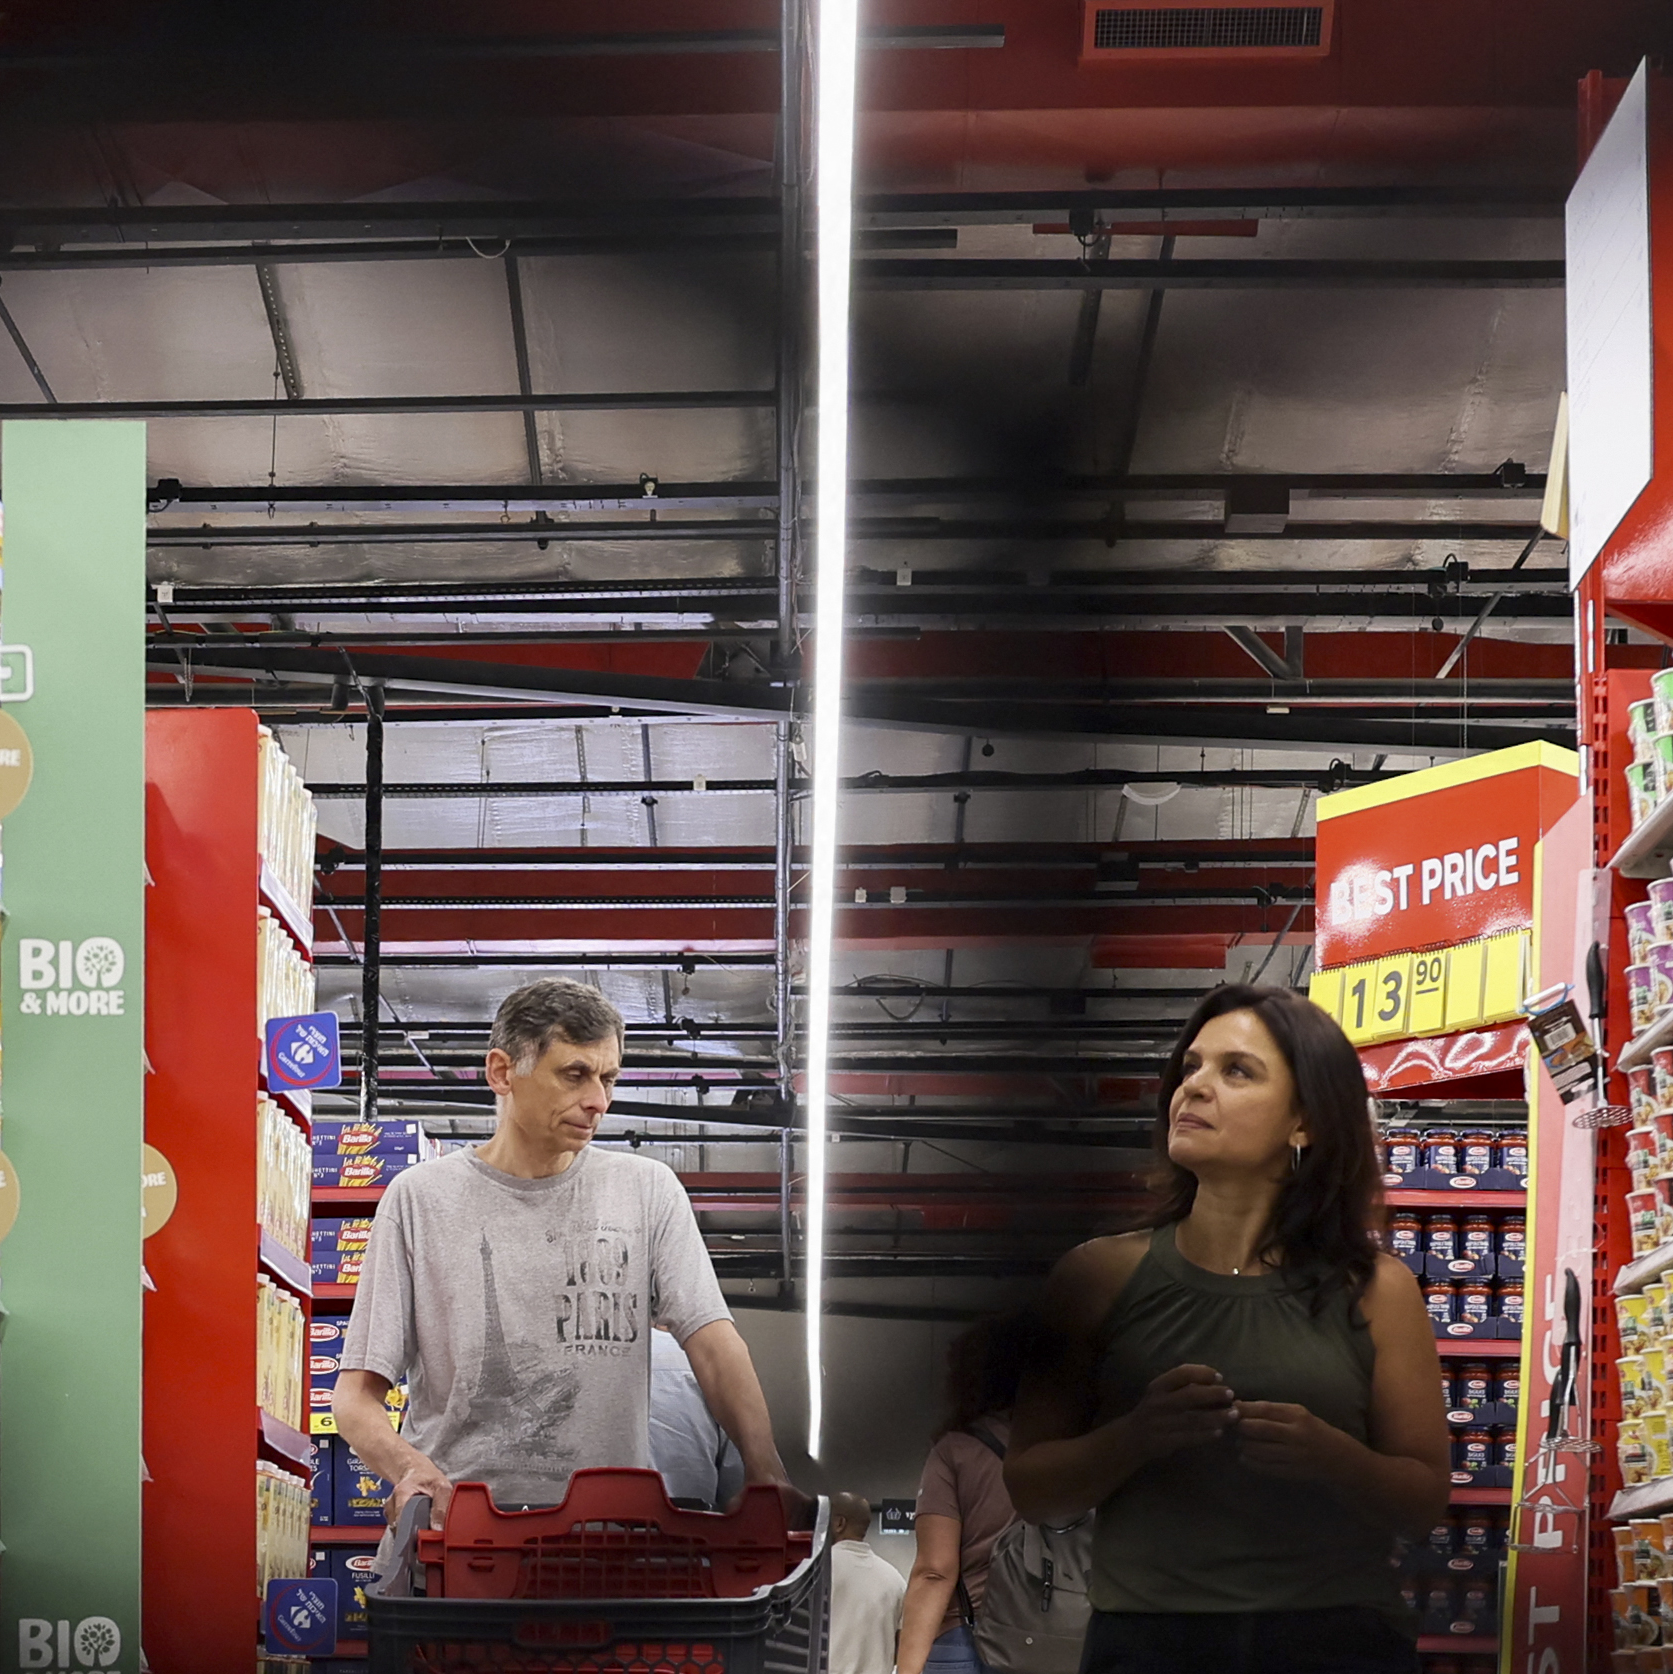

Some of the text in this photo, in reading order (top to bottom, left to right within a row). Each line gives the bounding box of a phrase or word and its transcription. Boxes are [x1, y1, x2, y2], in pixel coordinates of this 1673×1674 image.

[1330, 837, 1520, 925] BEST PRICE
[20, 937, 125, 989] BIO
[20, 991, 125, 1016] & MORE
[1352, 957, 1441, 1029] 13 90
[278, 1052, 306, 1078] Carrefour
[342, 1134, 374, 1144] Barilla
[142, 1171, 167, 1188] ORE
[344, 1167, 376, 1177] Barilla
[555, 1291, 638, 1343] PARIS
[564, 1345, 631, 1357] FRANCE
[310, 1393, 334, 1401] arill
[320, 1416, 333, 1427] 6
[277, 1614, 302, 1642] Carrefour
[19, 1616, 121, 1668] BIO
